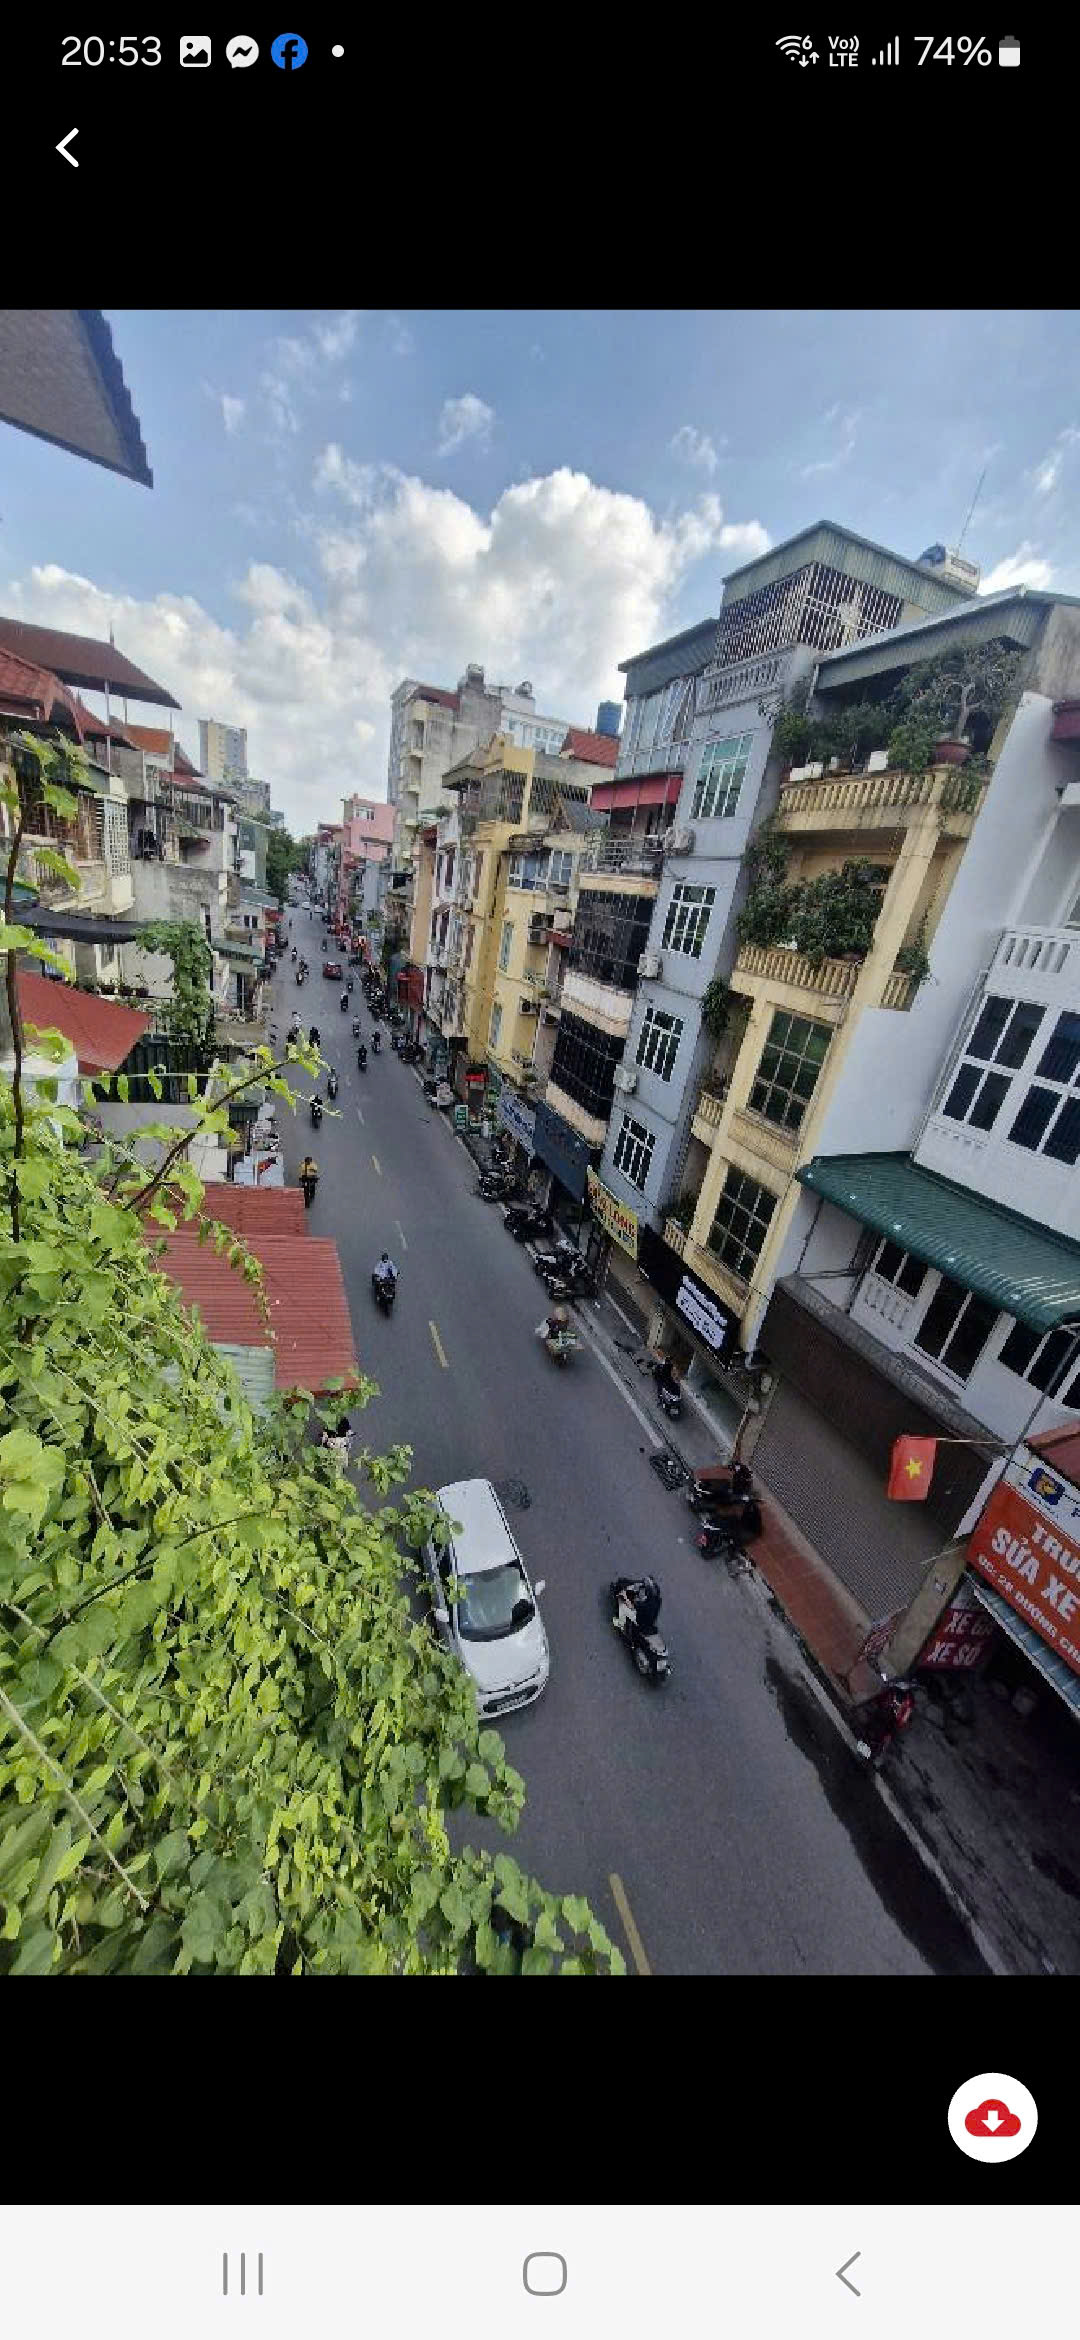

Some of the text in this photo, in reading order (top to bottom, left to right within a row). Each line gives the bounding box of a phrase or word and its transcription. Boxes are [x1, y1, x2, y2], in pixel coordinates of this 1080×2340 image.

[1031, 1521, 1080, 1583] TRU
[1040, 1573, 1080, 1622] XE
[944, 1611, 974, 1635] XE
[926, 1641, 956, 1664] XE
